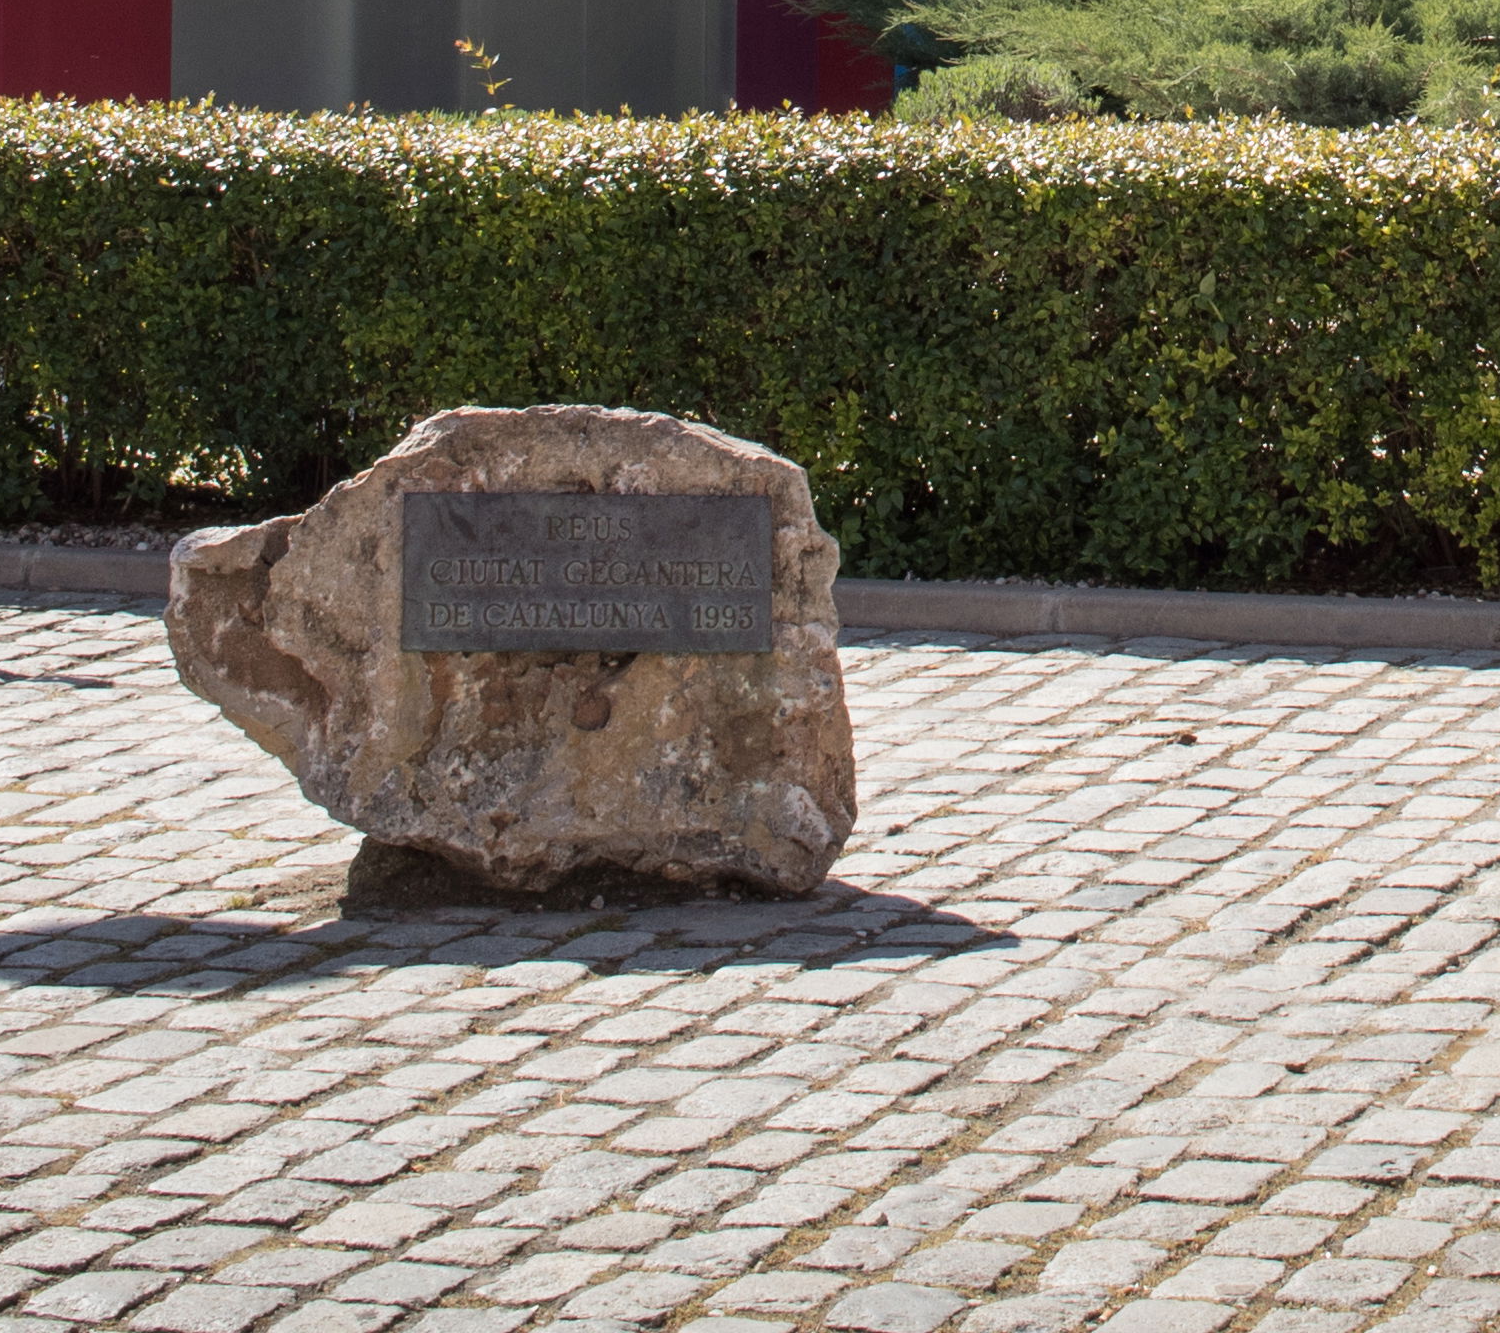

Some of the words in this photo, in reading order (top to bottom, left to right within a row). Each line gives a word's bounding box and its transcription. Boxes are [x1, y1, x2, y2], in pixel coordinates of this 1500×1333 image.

[545, 516, 632, 541] REUS
[430, 559, 545, 585] CIUTAT
[564, 560, 756, 586] GEGANTERA
[430, 602, 470, 628] DE
[484, 602, 670, 629] CATALUNYA
[692, 606, 754, 630] 1993
